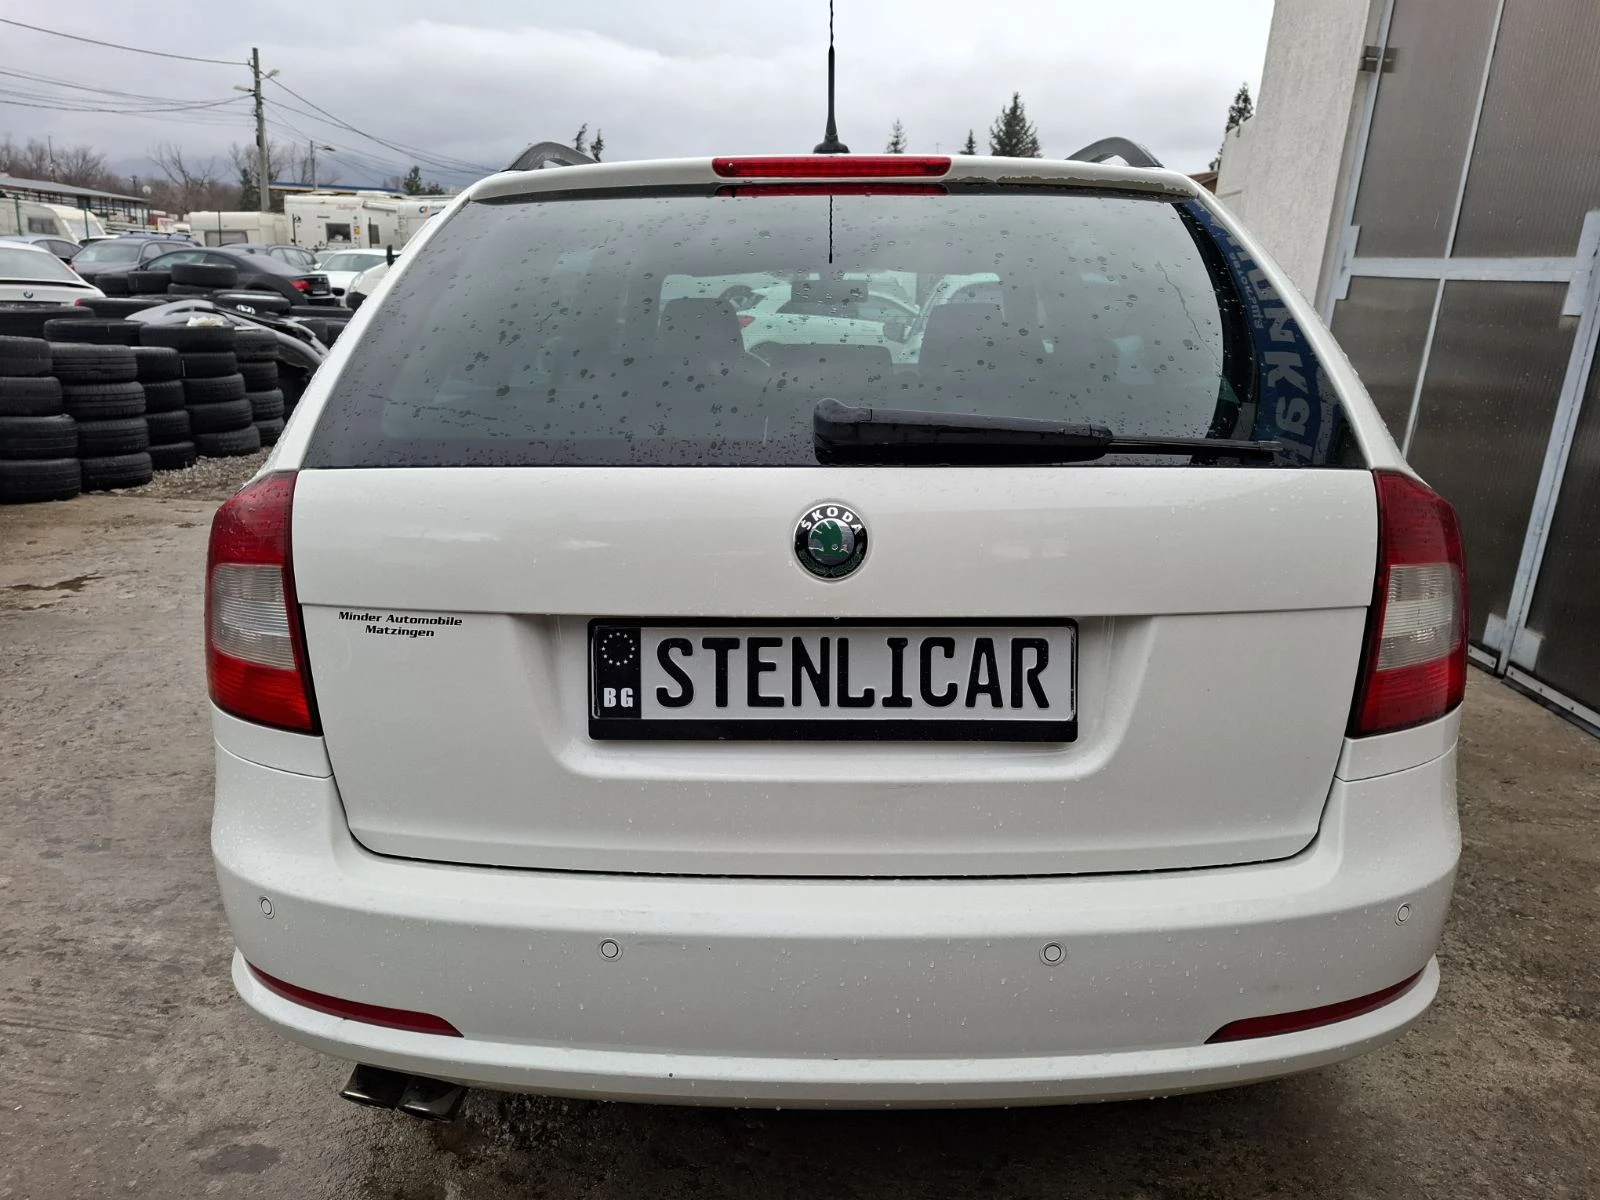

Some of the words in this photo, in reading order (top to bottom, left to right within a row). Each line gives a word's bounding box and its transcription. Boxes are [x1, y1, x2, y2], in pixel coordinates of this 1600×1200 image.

[338, 611, 382, 622] Minder
[385, 614, 463, 626] Automobile
[365, 625, 435, 638] Matzingen
[656, 636, 1050, 709] STENLICAR
[603, 687, 634, 708] BG
